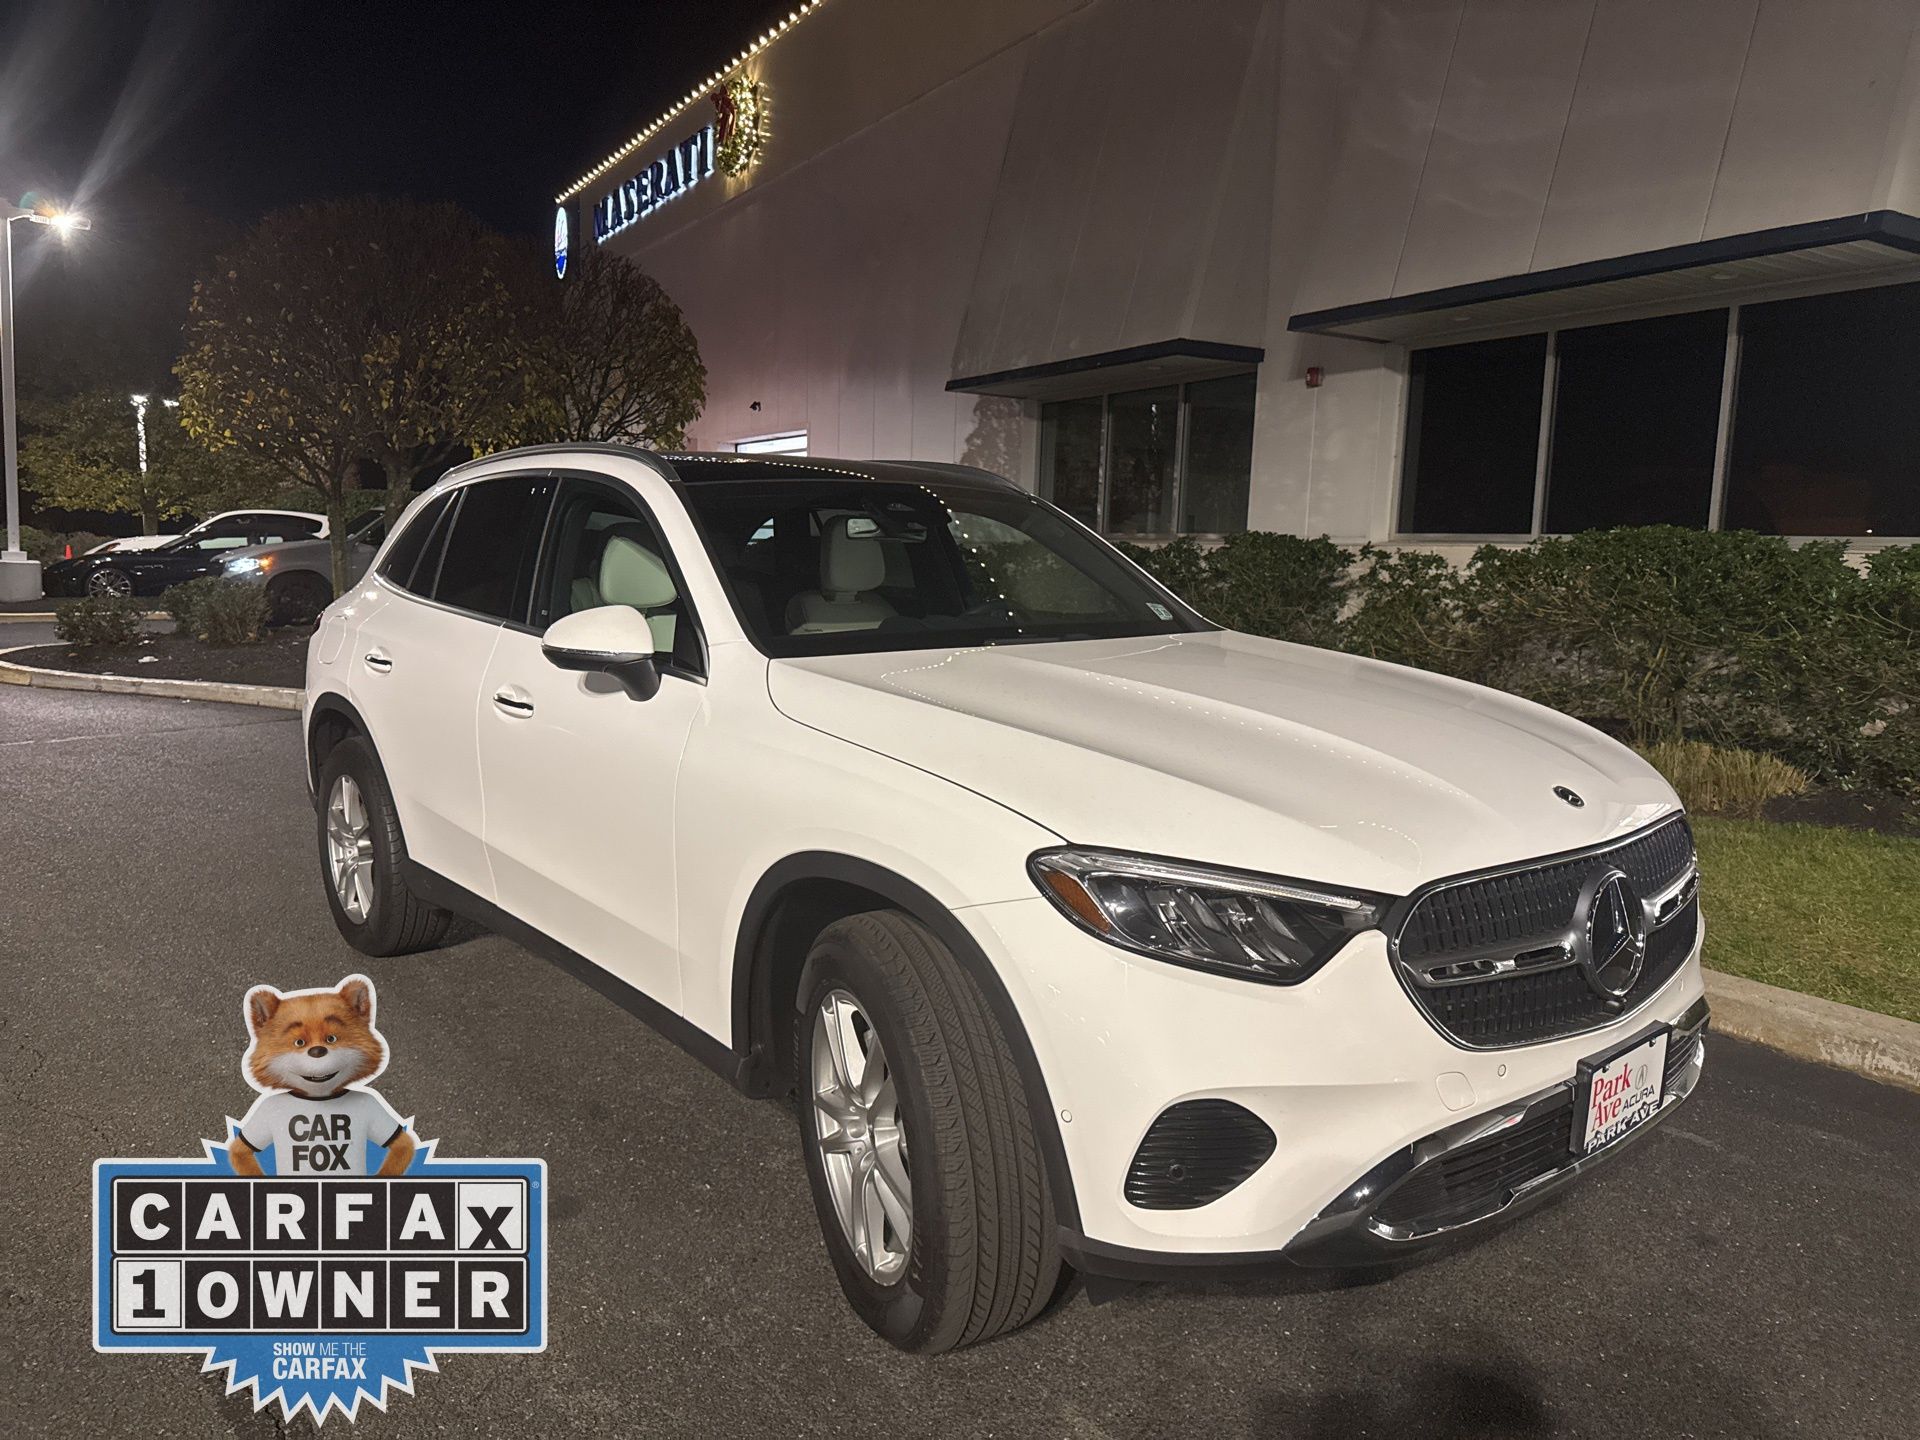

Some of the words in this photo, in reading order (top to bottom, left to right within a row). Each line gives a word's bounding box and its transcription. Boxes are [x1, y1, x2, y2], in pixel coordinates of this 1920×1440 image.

[593, 124, 715, 242] MASERATI
[1592, 1062, 1633, 1109] Park
[1622, 1084, 1655, 1112] ACURA
[1587, 1116, 1628, 1154] PARK
[1630, 1101, 1660, 1126] AVE
[1591, 1097, 1622, 1133] Ave
